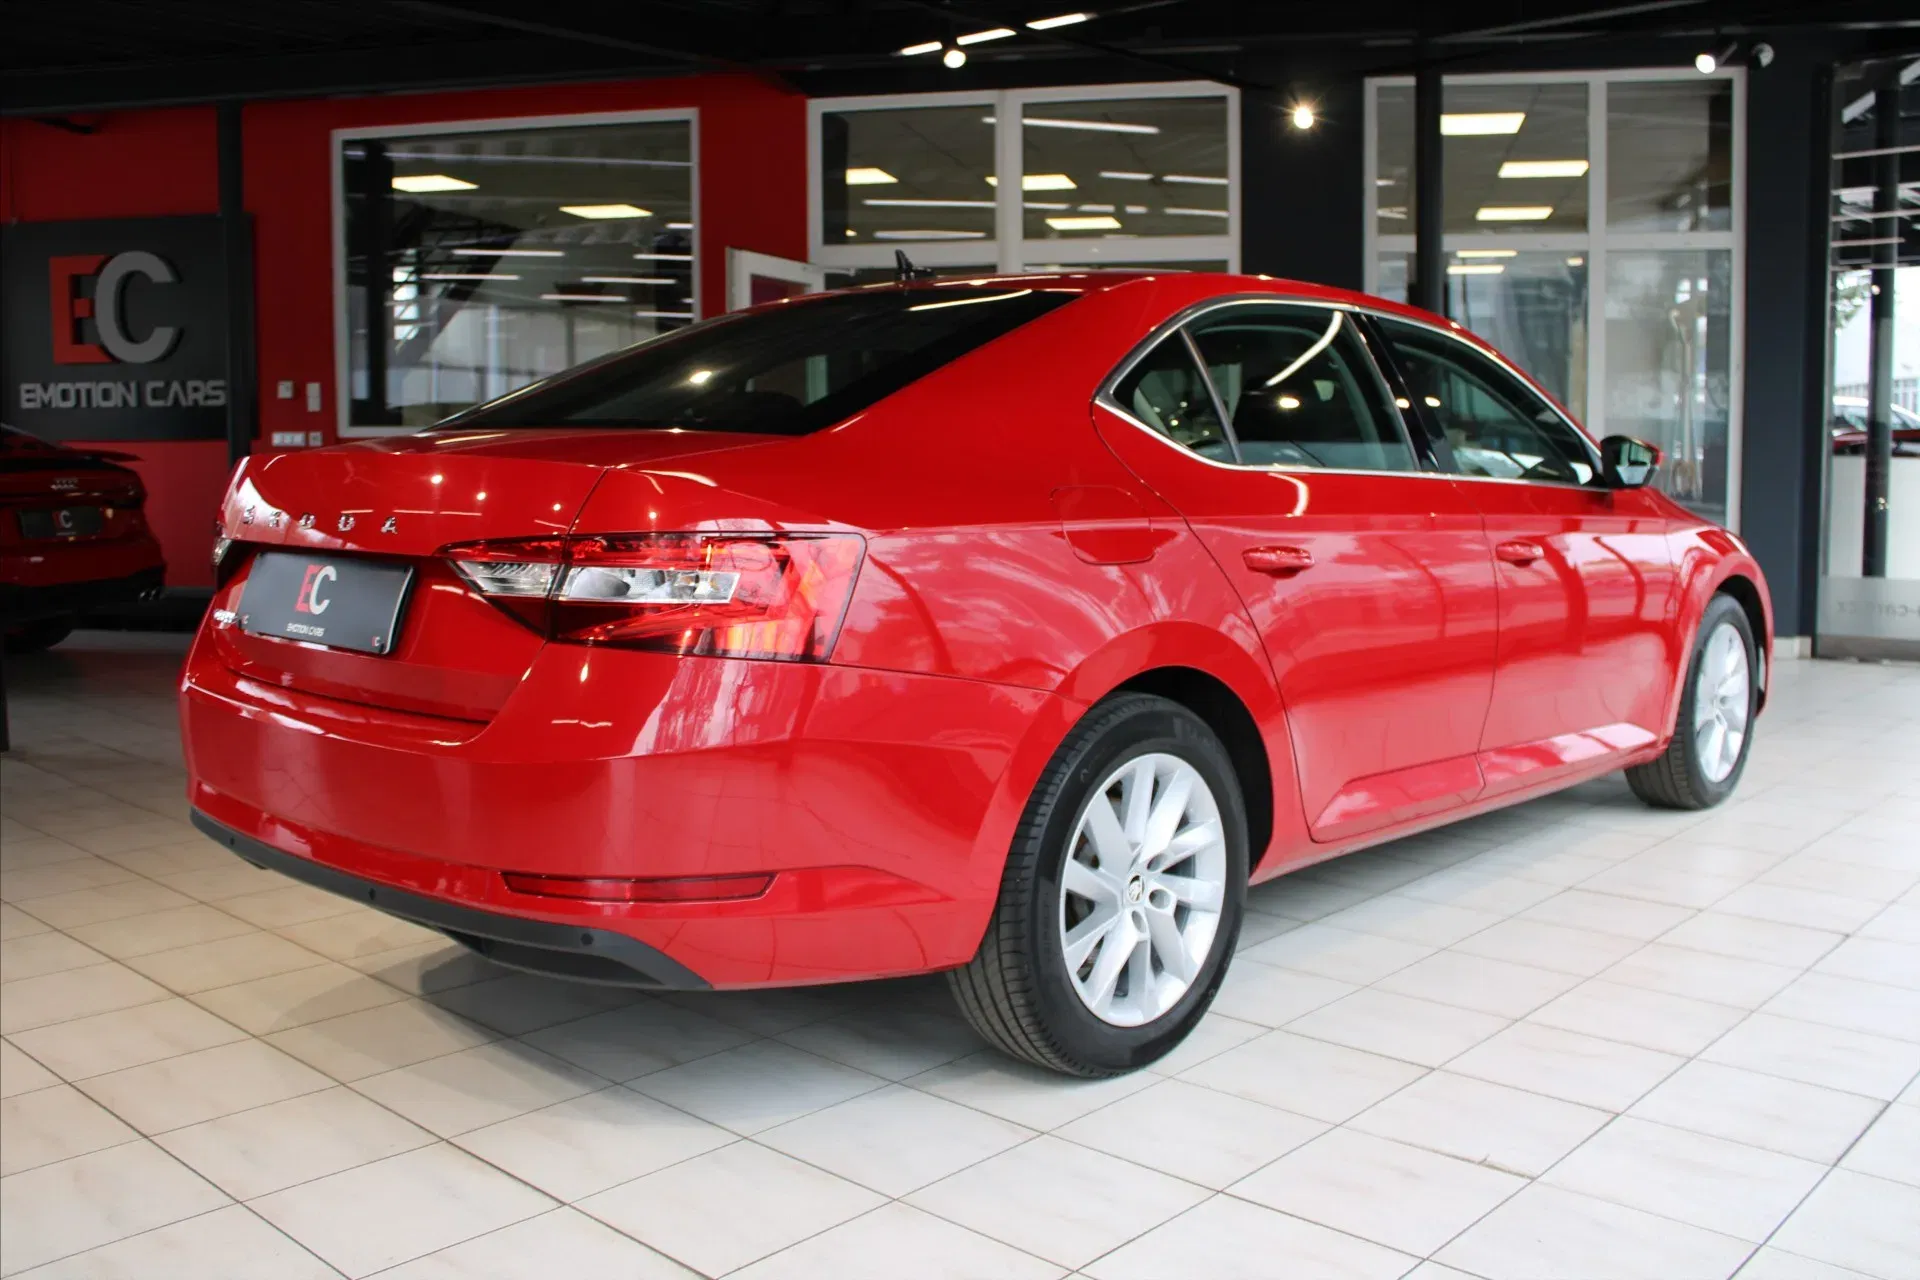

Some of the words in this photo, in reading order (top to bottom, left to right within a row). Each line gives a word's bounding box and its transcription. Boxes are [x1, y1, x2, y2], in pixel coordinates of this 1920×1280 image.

[49, 250, 177, 364] EC
[19, 381, 137, 408] EMOTION
[145, 380, 227, 407] CARS
[295, 564, 337, 615] EC
